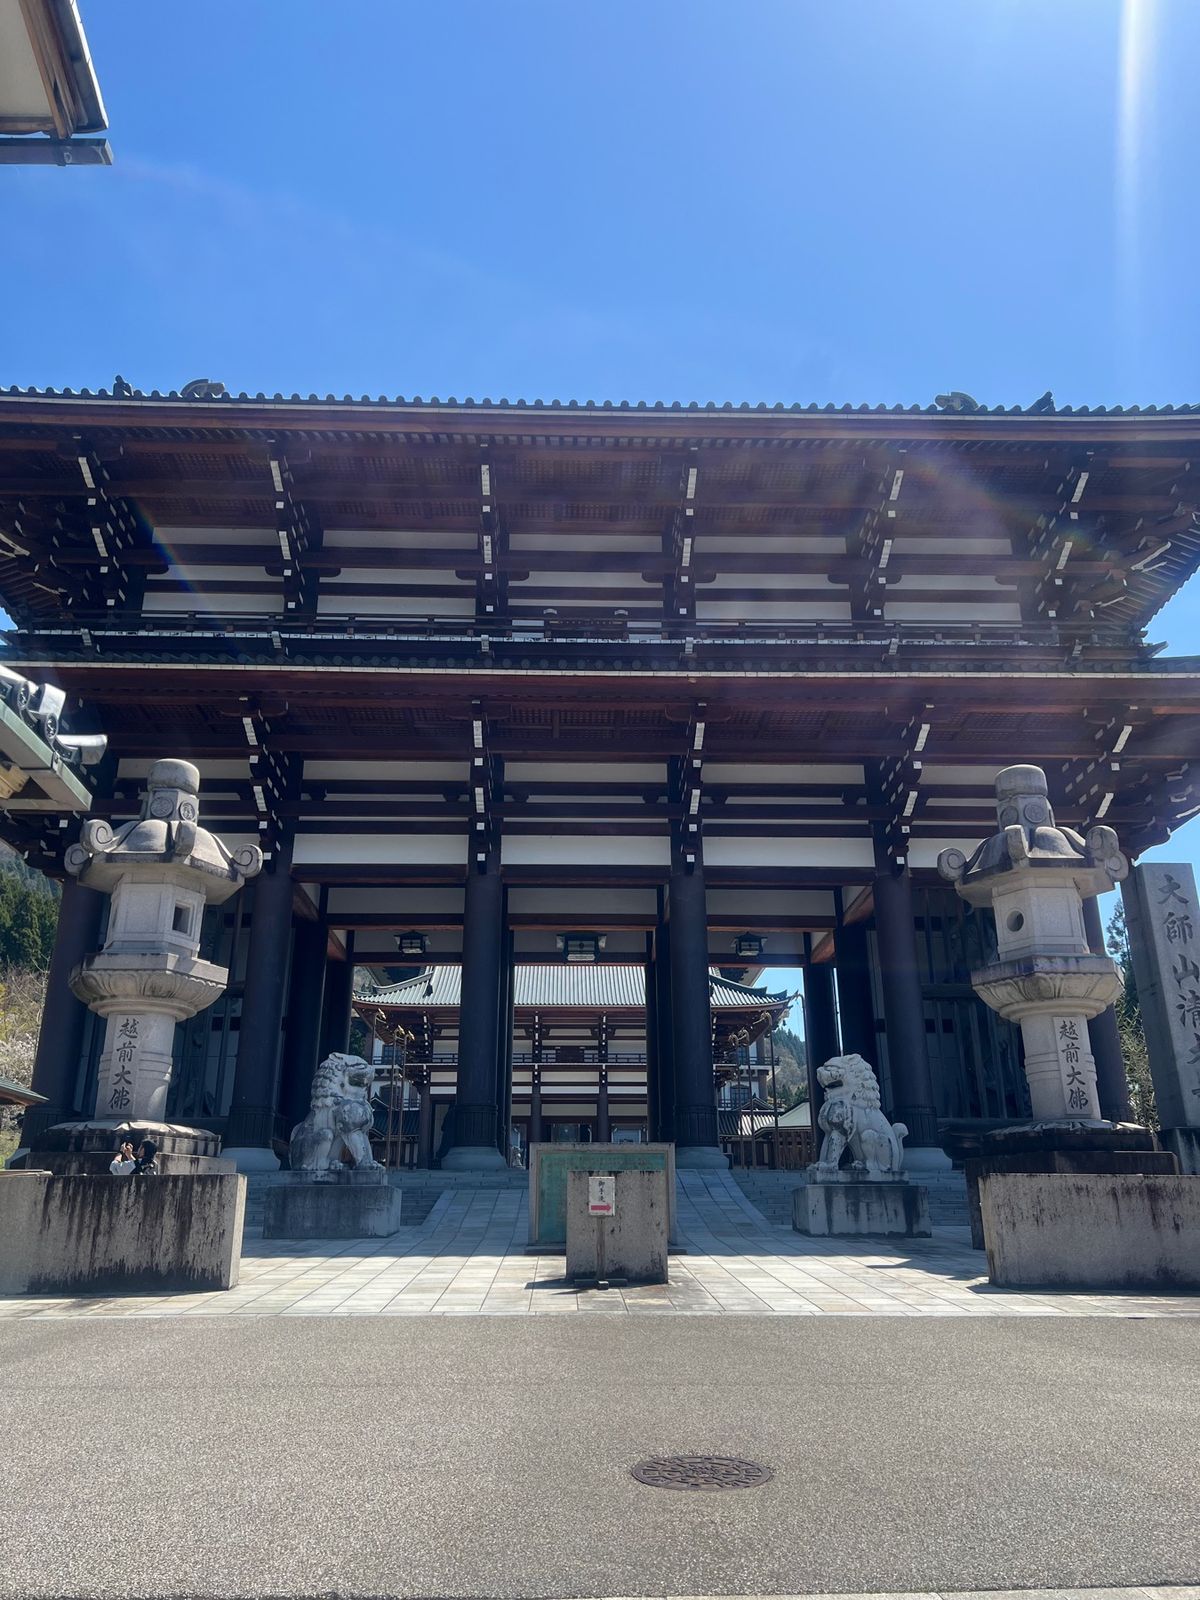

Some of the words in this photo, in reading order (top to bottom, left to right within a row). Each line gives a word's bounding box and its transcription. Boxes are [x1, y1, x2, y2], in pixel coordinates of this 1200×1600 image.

[1157, 874, 1200, 1099] 大師山清
[108, 1018, 140, 1110] 越前大佛
[1059, 1020, 1089, 1110] 越前大佛
